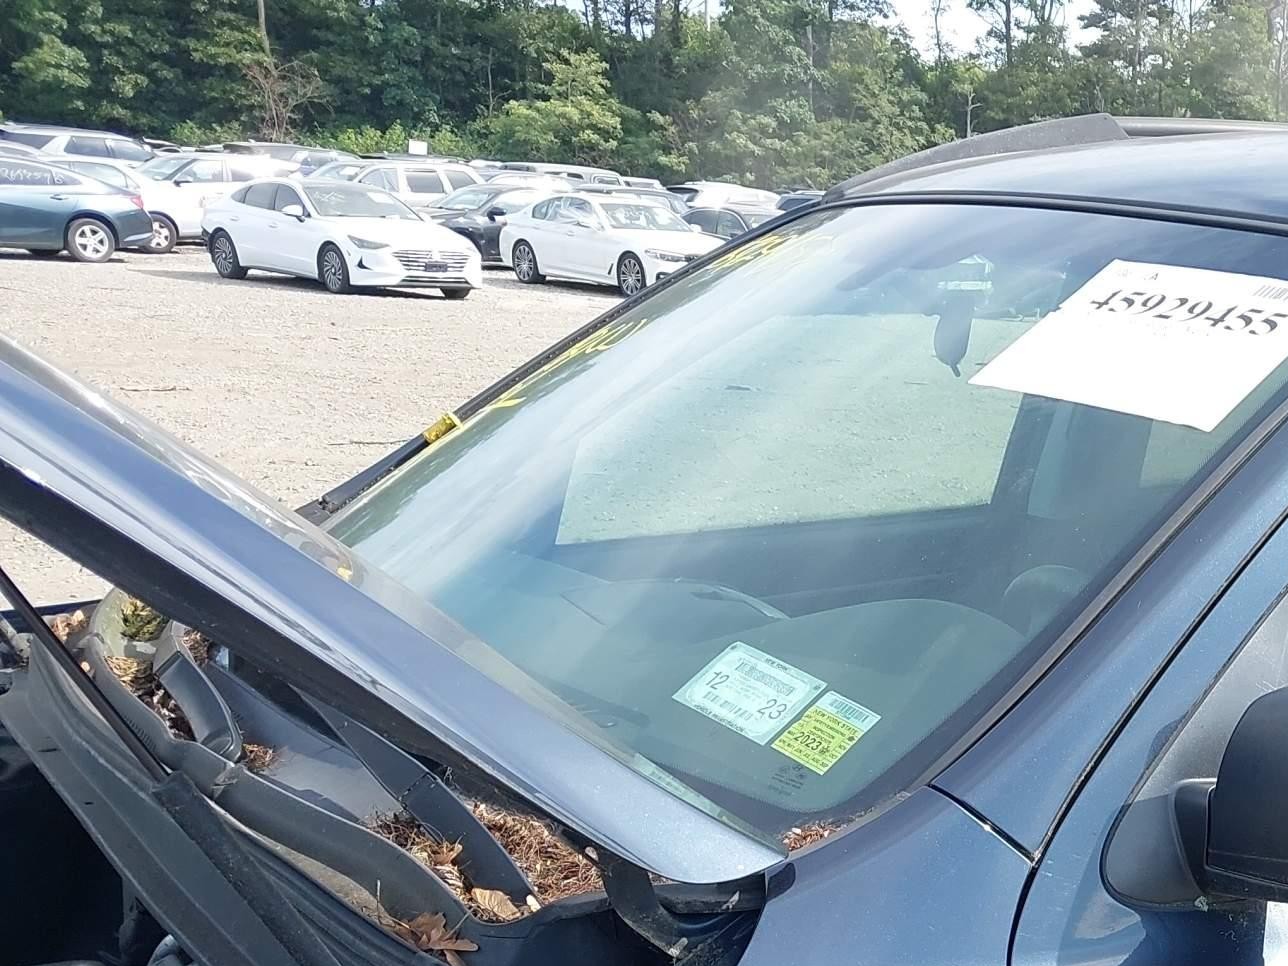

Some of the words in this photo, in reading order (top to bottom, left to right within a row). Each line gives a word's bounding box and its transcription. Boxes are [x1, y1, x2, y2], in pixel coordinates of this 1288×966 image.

[704, 671, 730, 690] 12
[756, 698, 788, 720] 23
[794, 731, 822, 751] 2023
